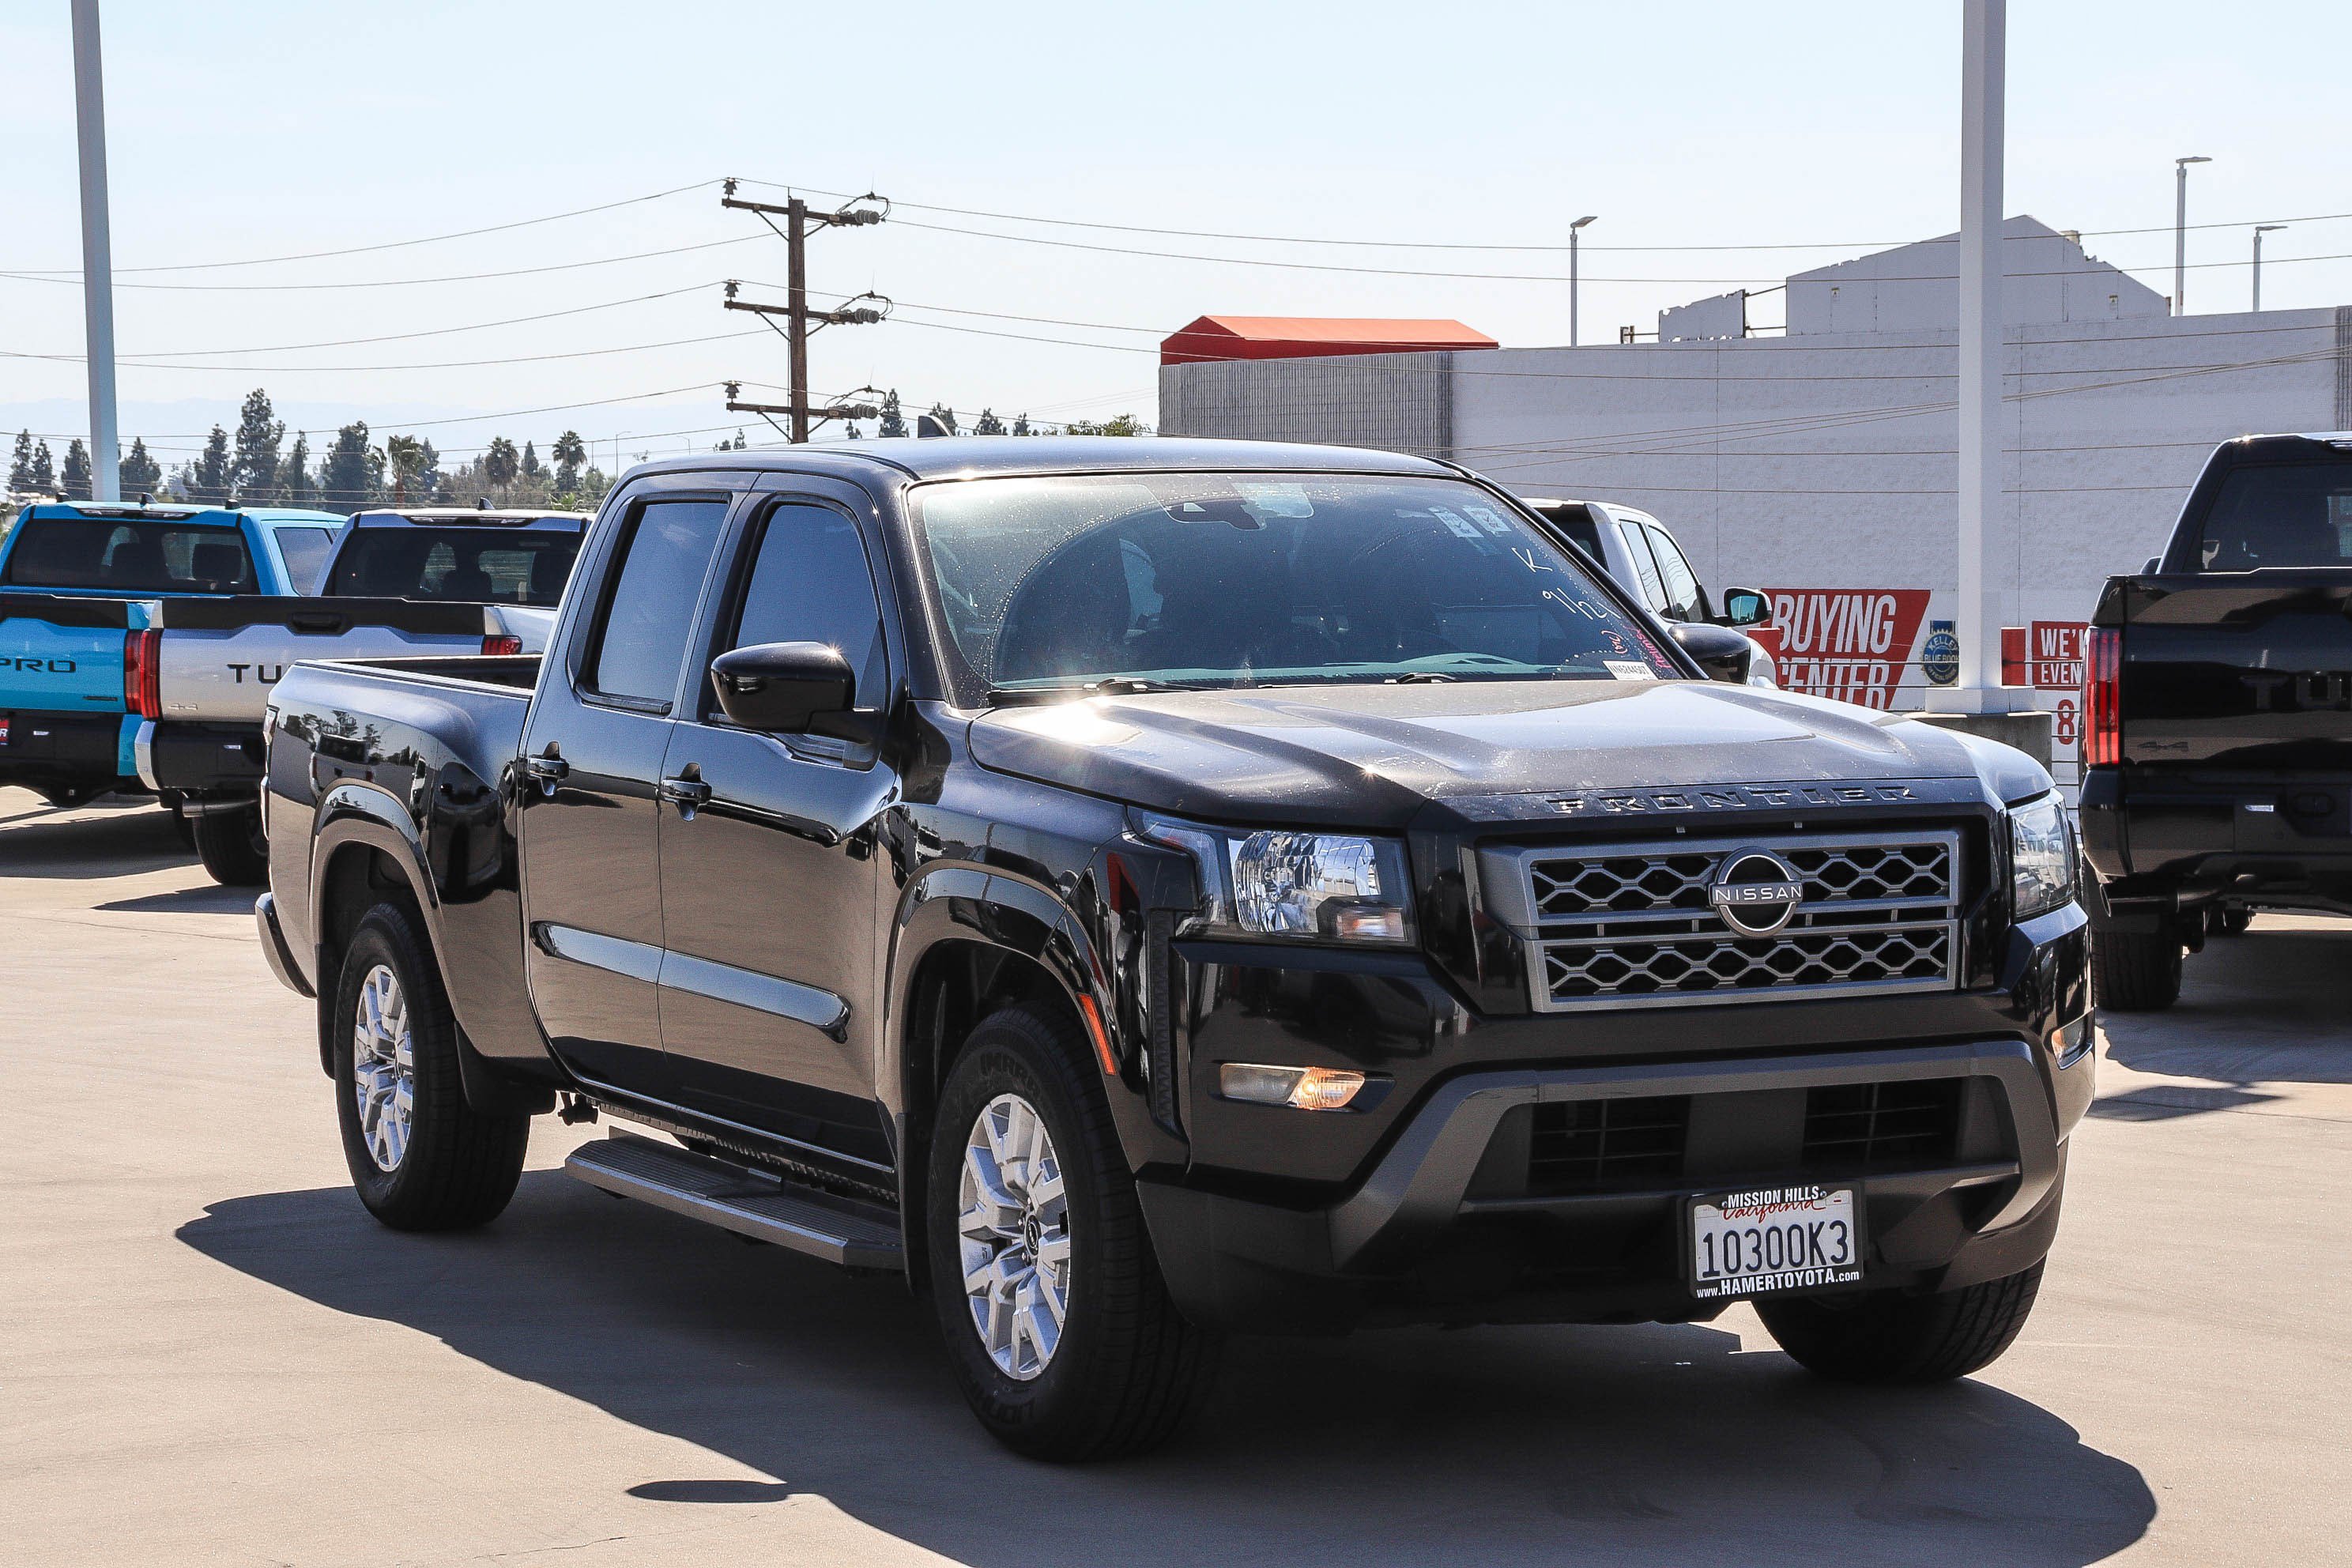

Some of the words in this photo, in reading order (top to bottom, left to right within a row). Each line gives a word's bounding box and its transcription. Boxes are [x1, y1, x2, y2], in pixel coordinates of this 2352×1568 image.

[1511, 547, 1553, 572] K
[1772, 594, 1896, 654] BUYING
[227, 663, 291, 684] TU
[2041, 662, 2082, 684] EVEN
[2058, 699, 2075, 744] 8
[1545, 786, 1919, 813] FRONTIER
[1714, 885, 1802, 901] NISSAN
[1728, 1189, 1781, 1208] MISSION
[1785, 1185, 1819, 1202] HILLS
[1723, 1200, 1826, 1223] California
[1702, 1219, 1849, 1278] 10300K3
[1696, 1268, 1860, 1298] www.HAMERTOYOTA.com
